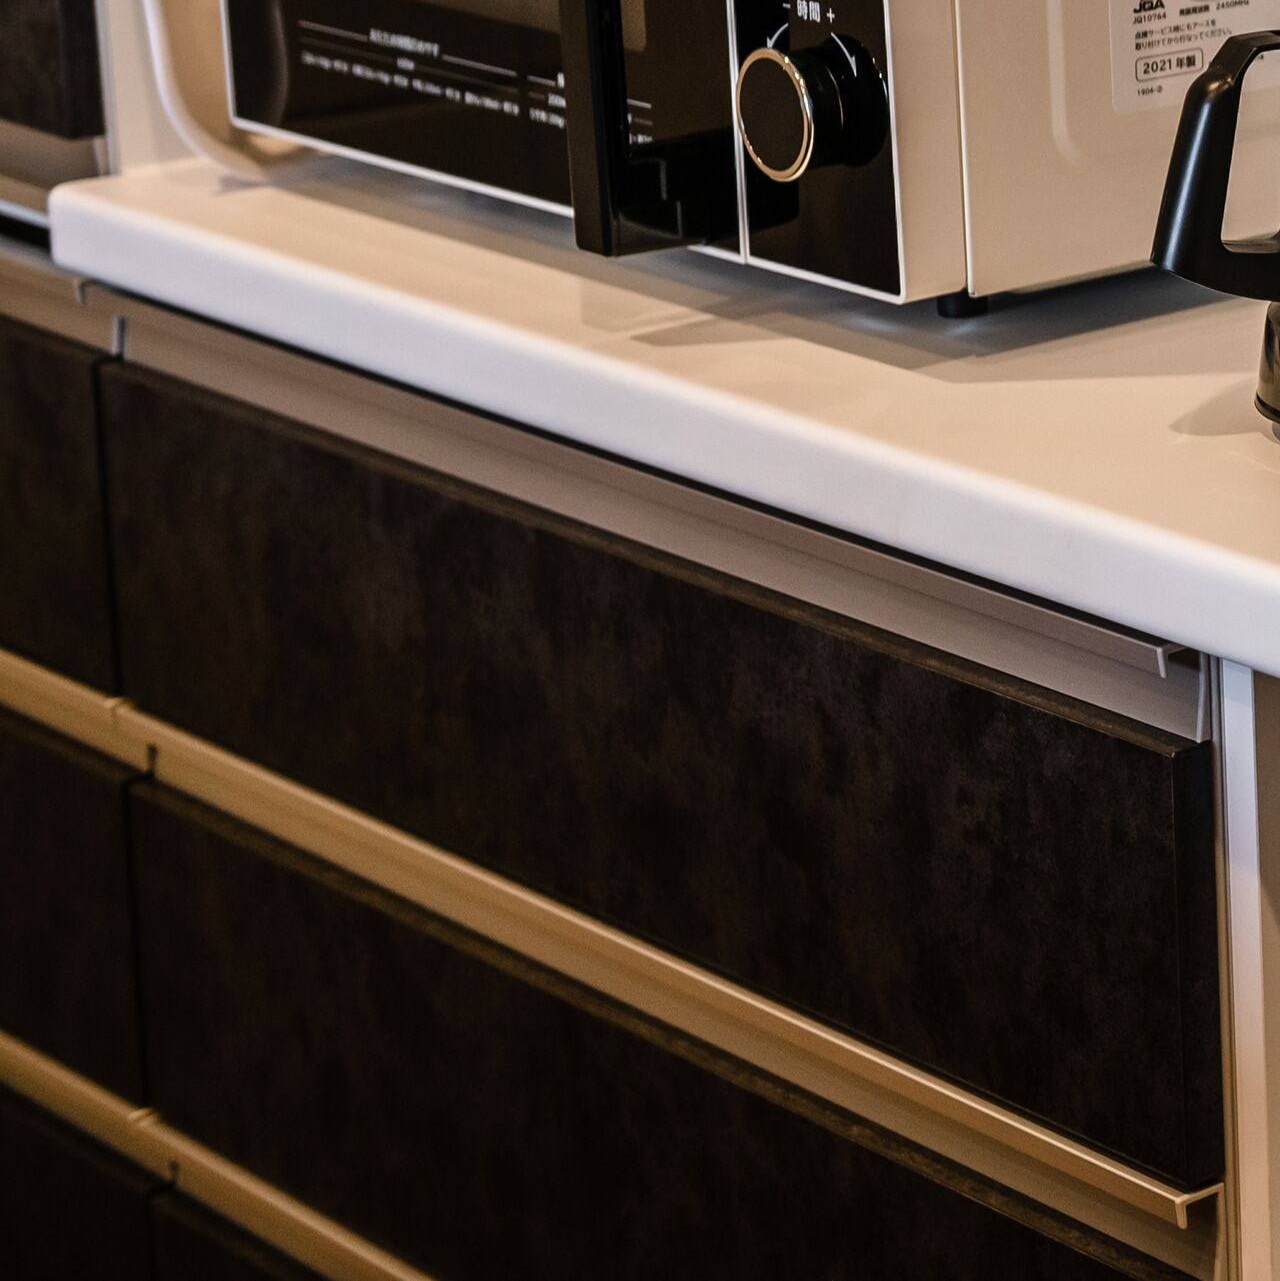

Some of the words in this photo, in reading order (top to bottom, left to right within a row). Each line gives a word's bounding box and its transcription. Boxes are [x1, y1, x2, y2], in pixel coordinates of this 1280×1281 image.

[797, 0, 821, 23] 時間
[1215, 0, 1250, 11] 2450MHz
[1132, 11, 1167, 25] JQ10764
